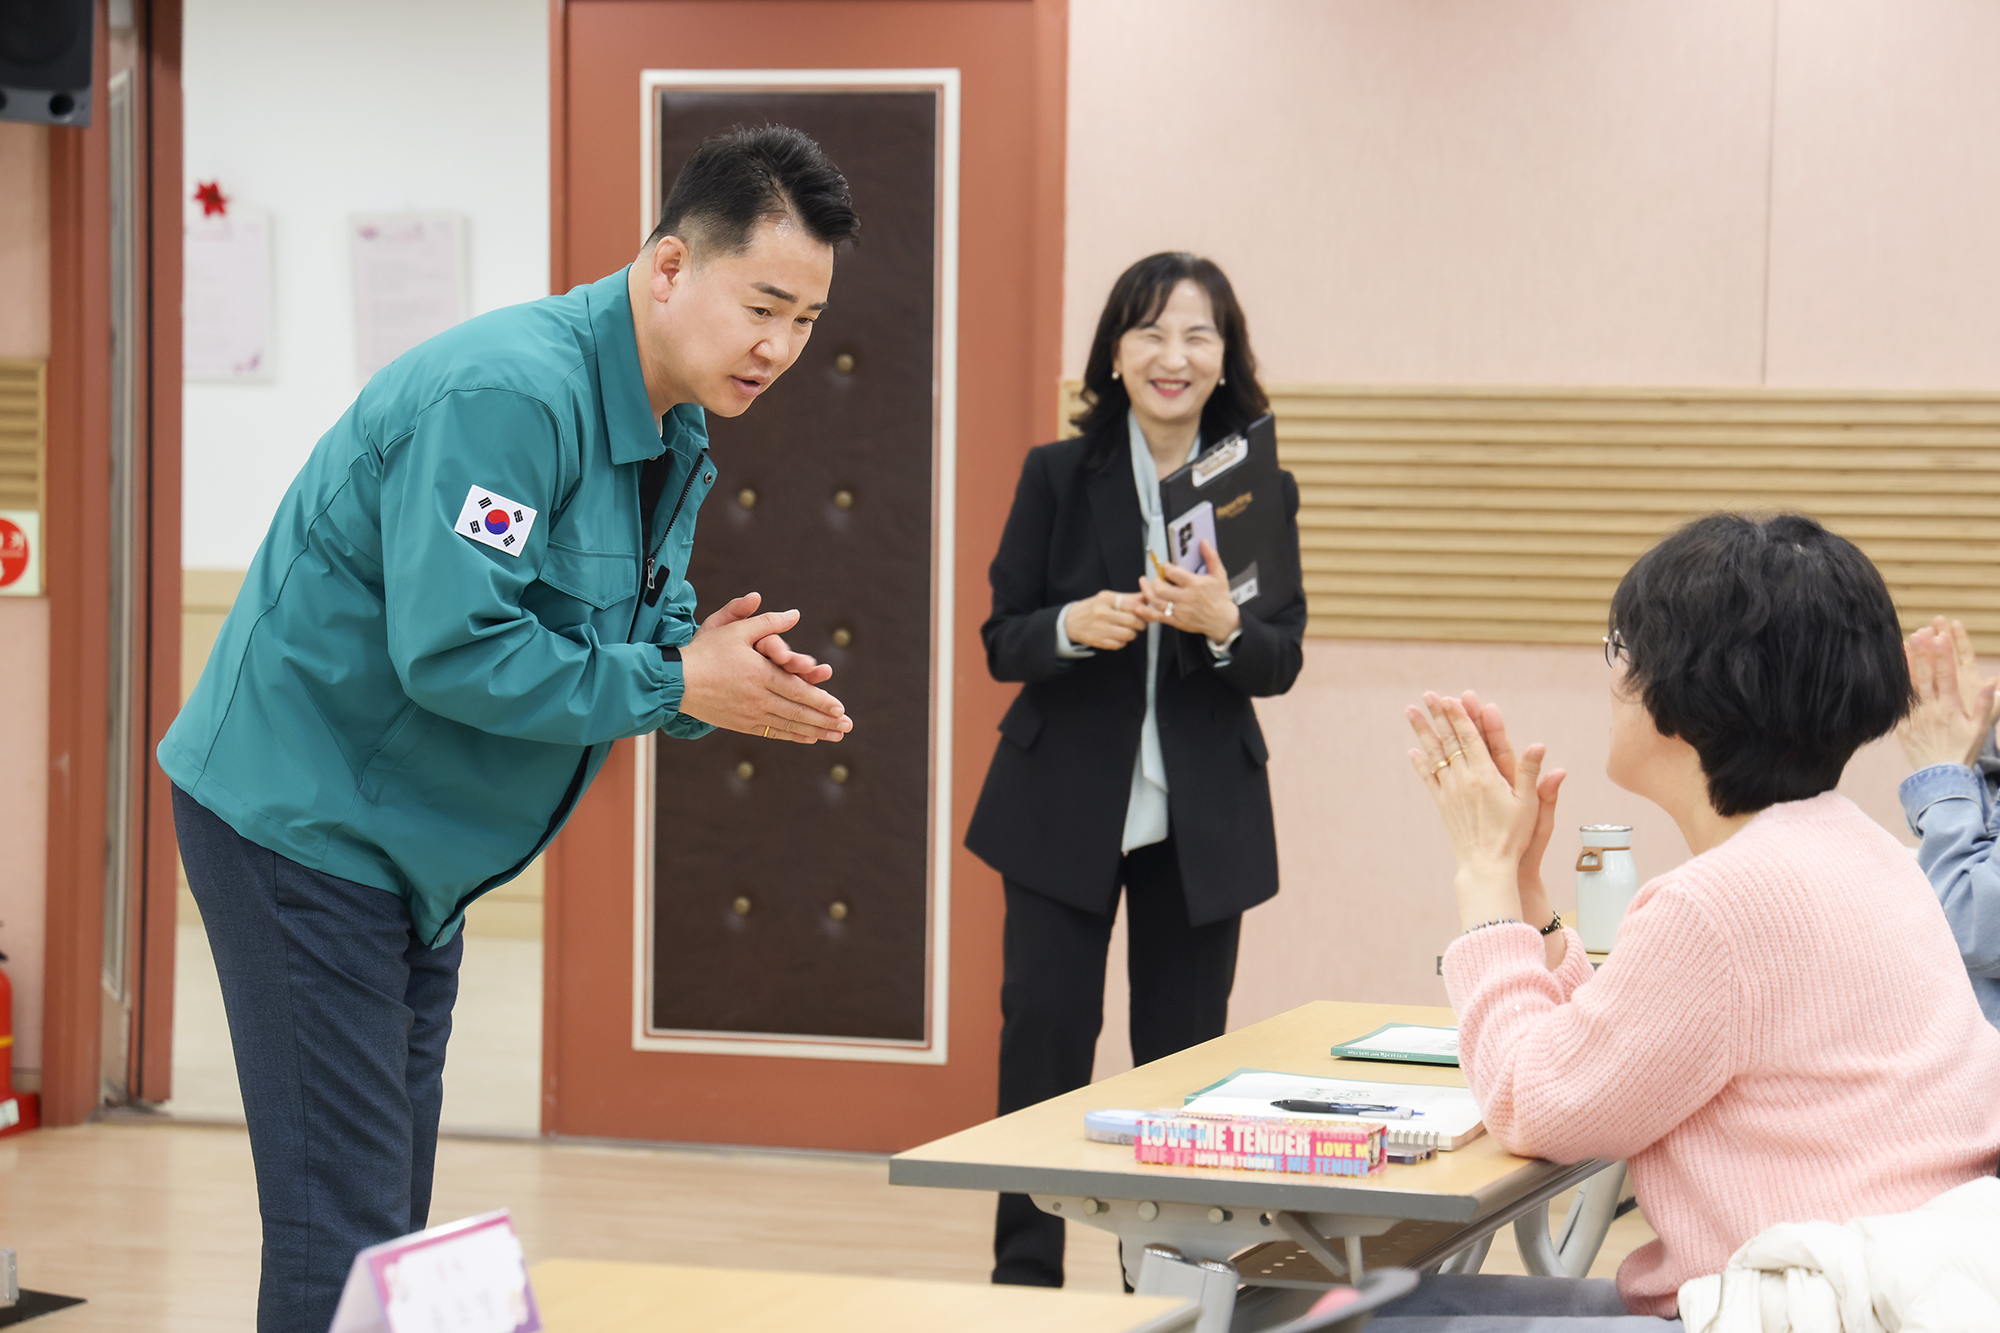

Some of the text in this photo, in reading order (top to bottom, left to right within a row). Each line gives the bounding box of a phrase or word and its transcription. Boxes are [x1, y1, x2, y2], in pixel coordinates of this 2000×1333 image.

[1141, 1119, 1311, 1156] LOVE ME TENDER
[1316, 1141, 1352, 1158] LOVE
[1194, 1151, 1219, 1166] LOVE
[1220, 1153, 1235, 1168] ME
[1287, 1155, 1310, 1173] ME
